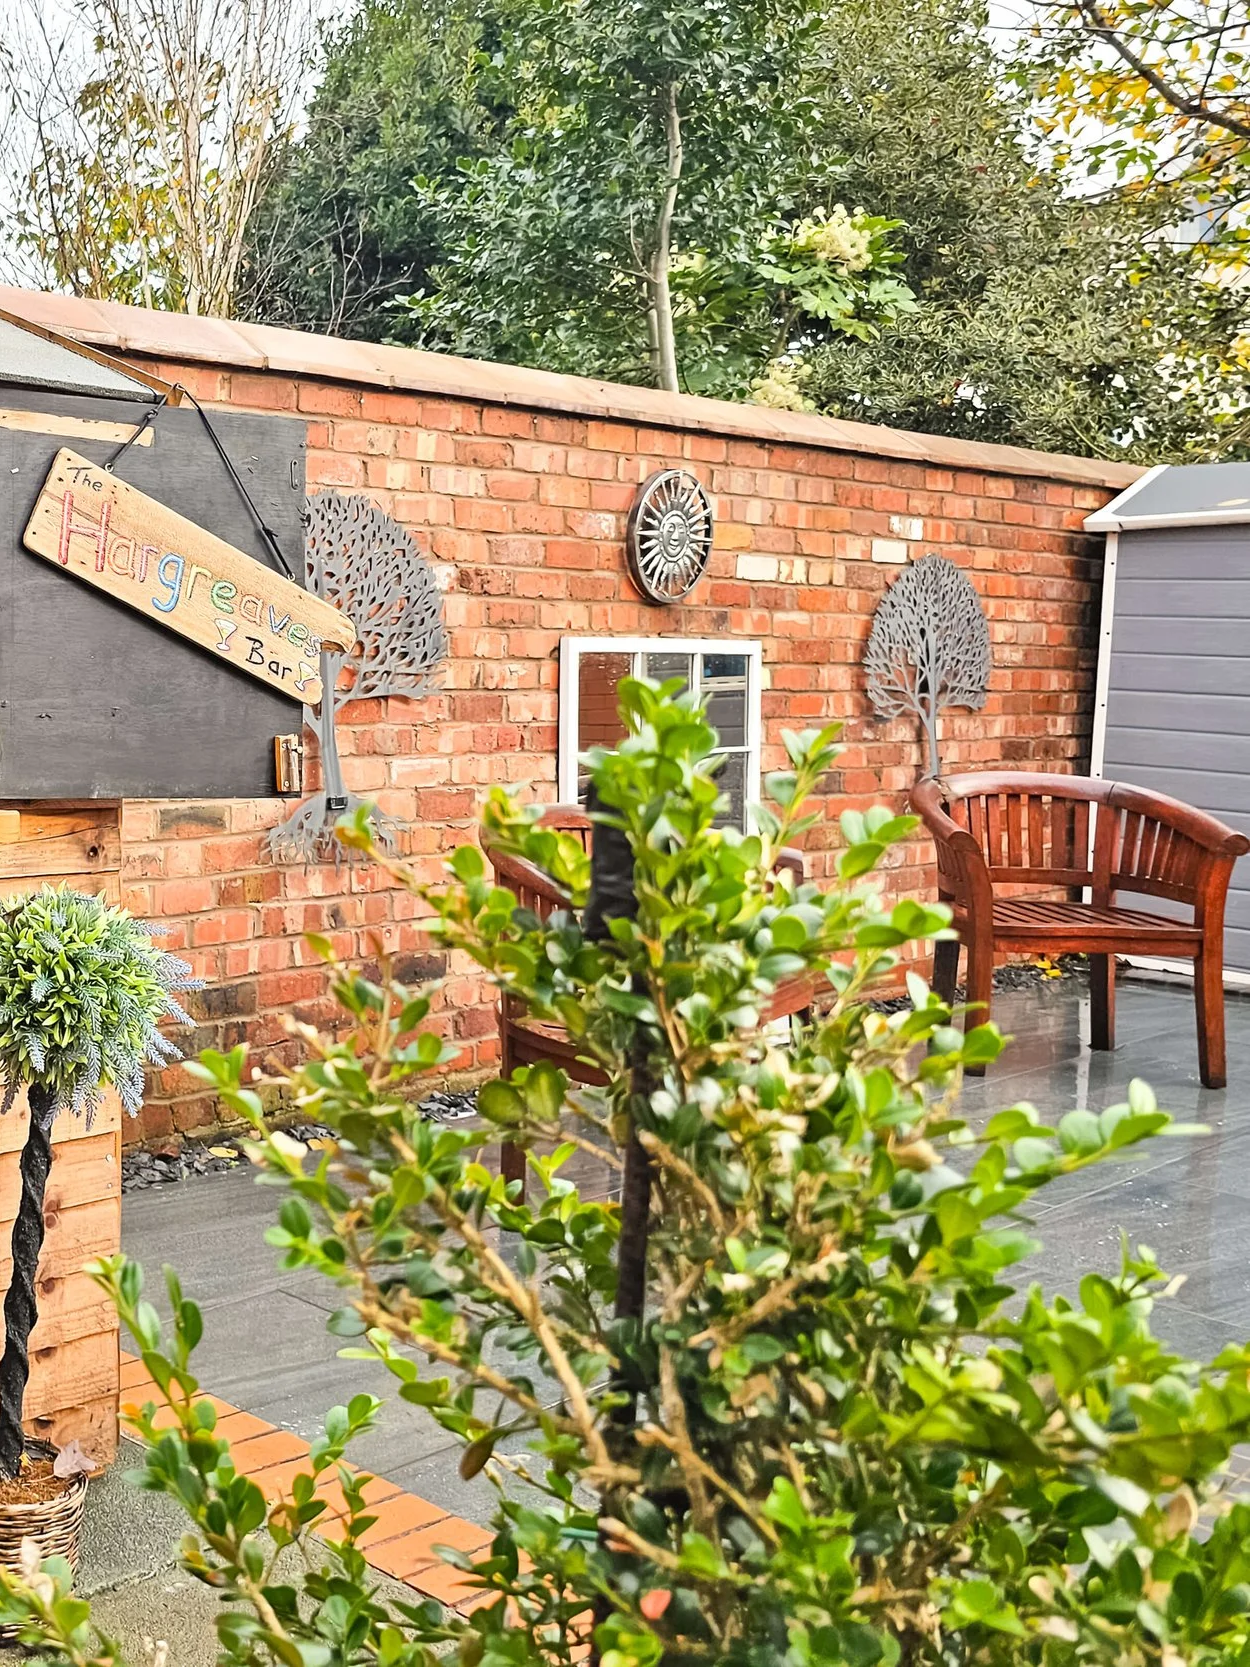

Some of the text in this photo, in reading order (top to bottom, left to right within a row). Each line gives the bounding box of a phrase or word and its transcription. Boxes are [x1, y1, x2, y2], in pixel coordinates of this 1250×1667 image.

[67, 466, 103, 492] The
[58, 490, 323, 658] Hargreaves
[245, 635, 293, 681] Bar
